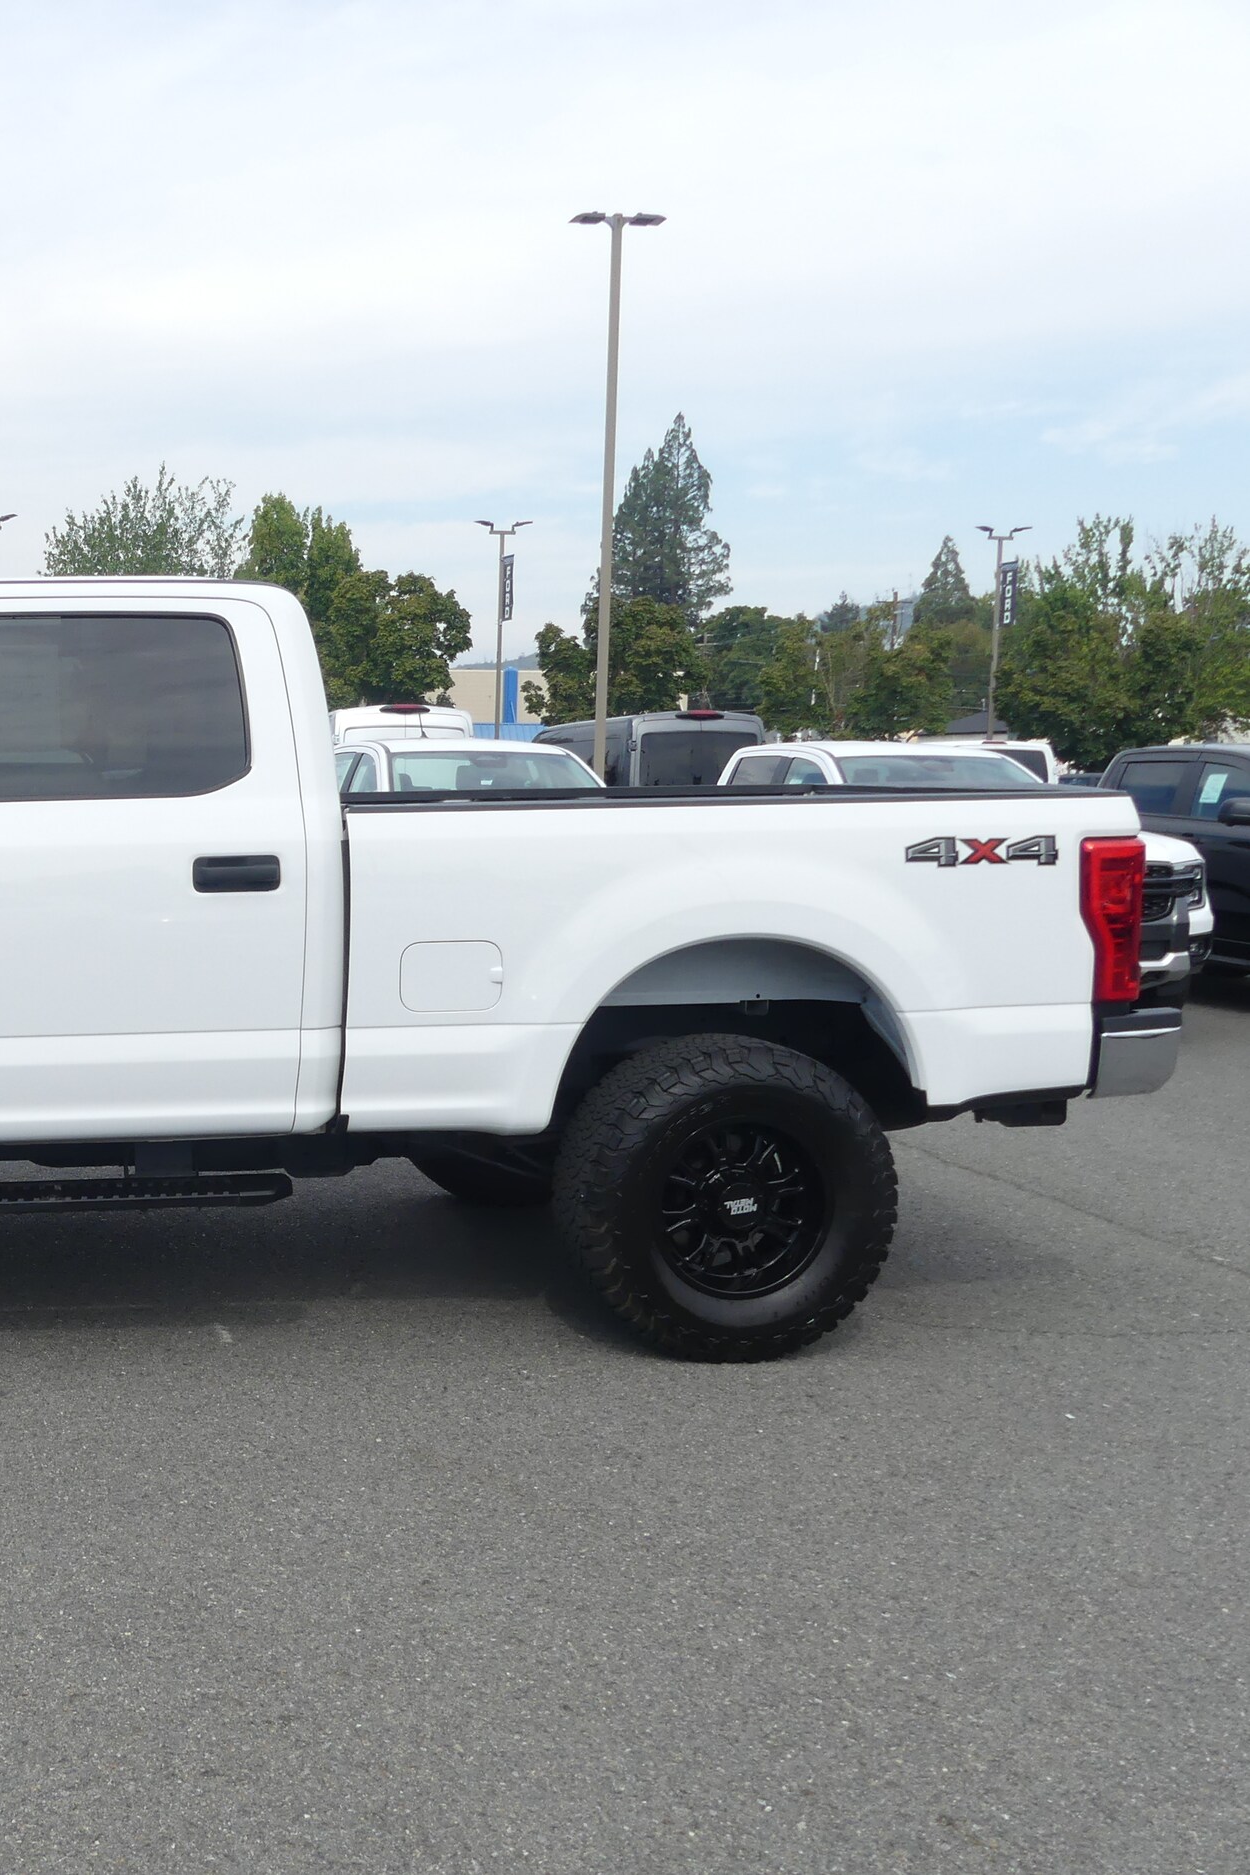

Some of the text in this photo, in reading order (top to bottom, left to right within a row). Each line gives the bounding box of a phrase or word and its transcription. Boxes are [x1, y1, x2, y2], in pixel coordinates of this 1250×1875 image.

[1003, 571, 1013, 625] FORD
[723, 1197, 754, 1209] METAL
[730, 1203, 758, 1215] MOTO
